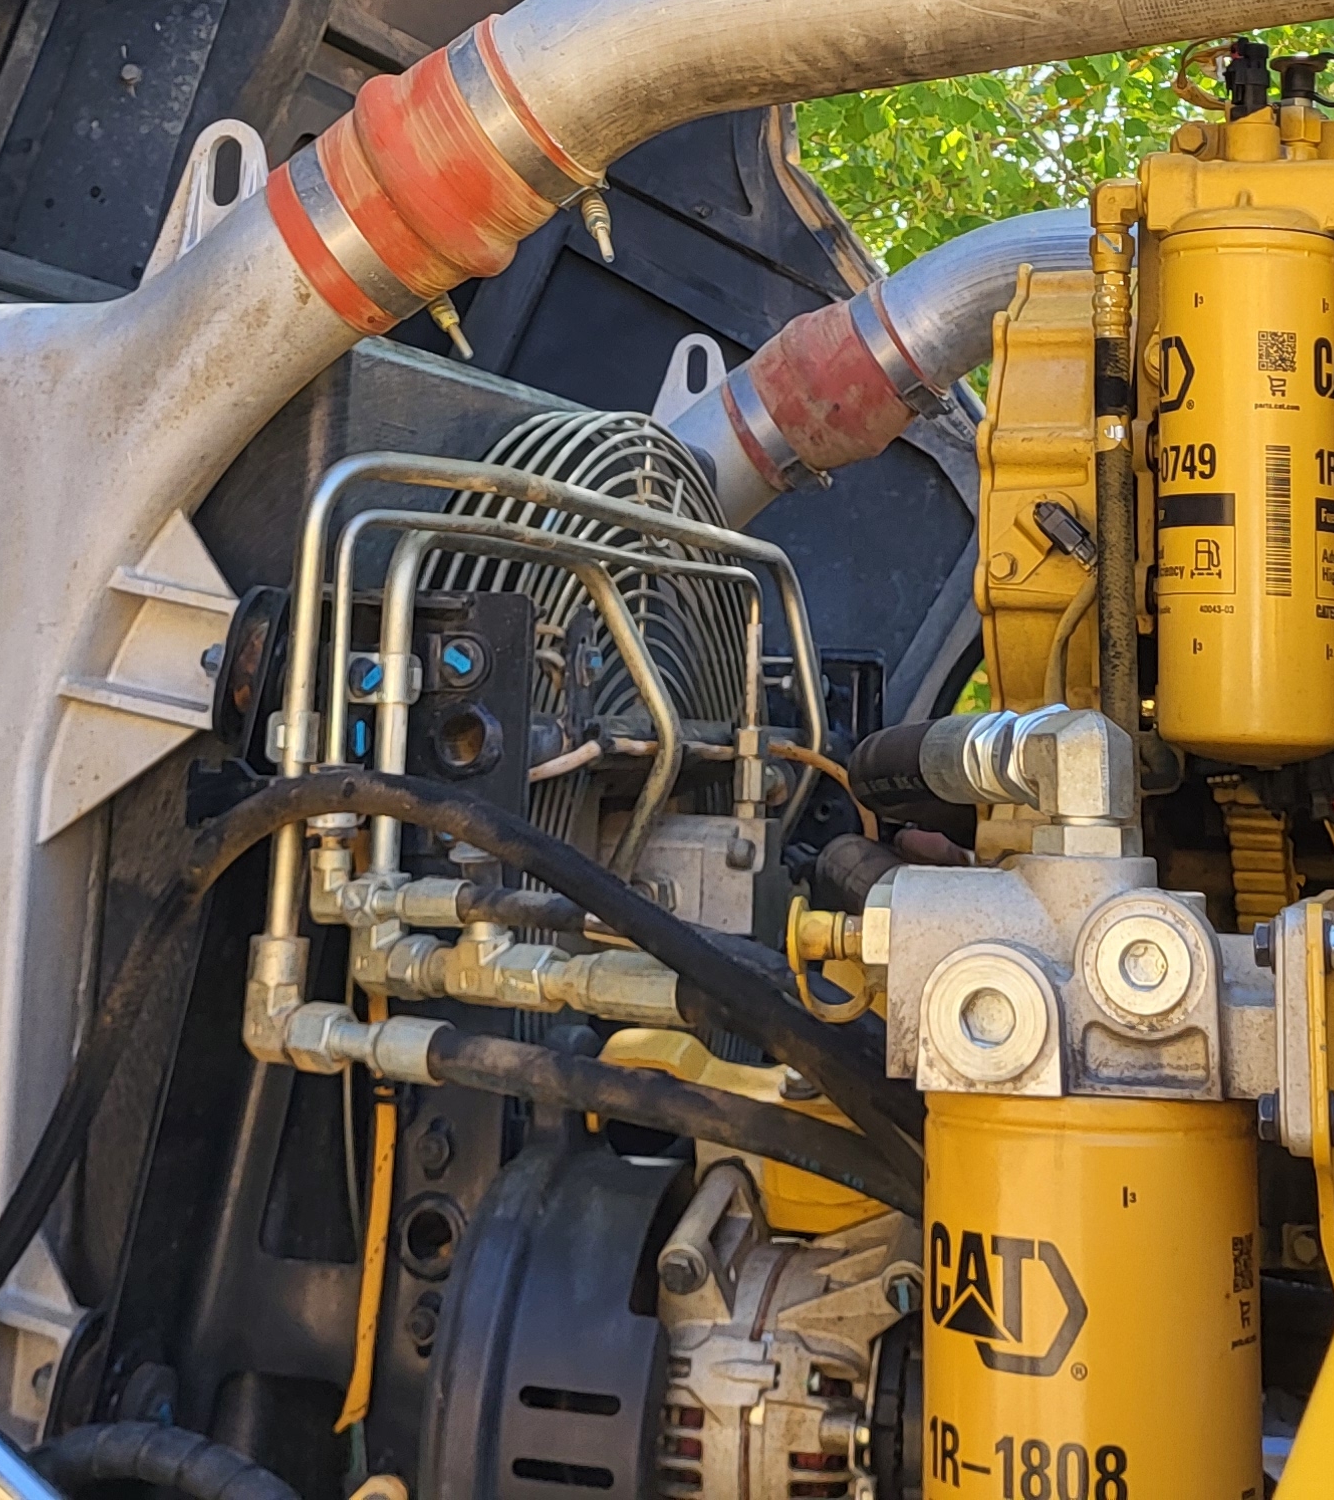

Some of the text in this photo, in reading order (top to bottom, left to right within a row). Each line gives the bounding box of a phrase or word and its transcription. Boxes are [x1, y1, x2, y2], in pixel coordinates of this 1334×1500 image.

[1253, 402, 1301, 412] parts.cat.com
[930, 1220, 1036, 1343] CAT
[929, 1414, 1127, 1500] 1R-1808
